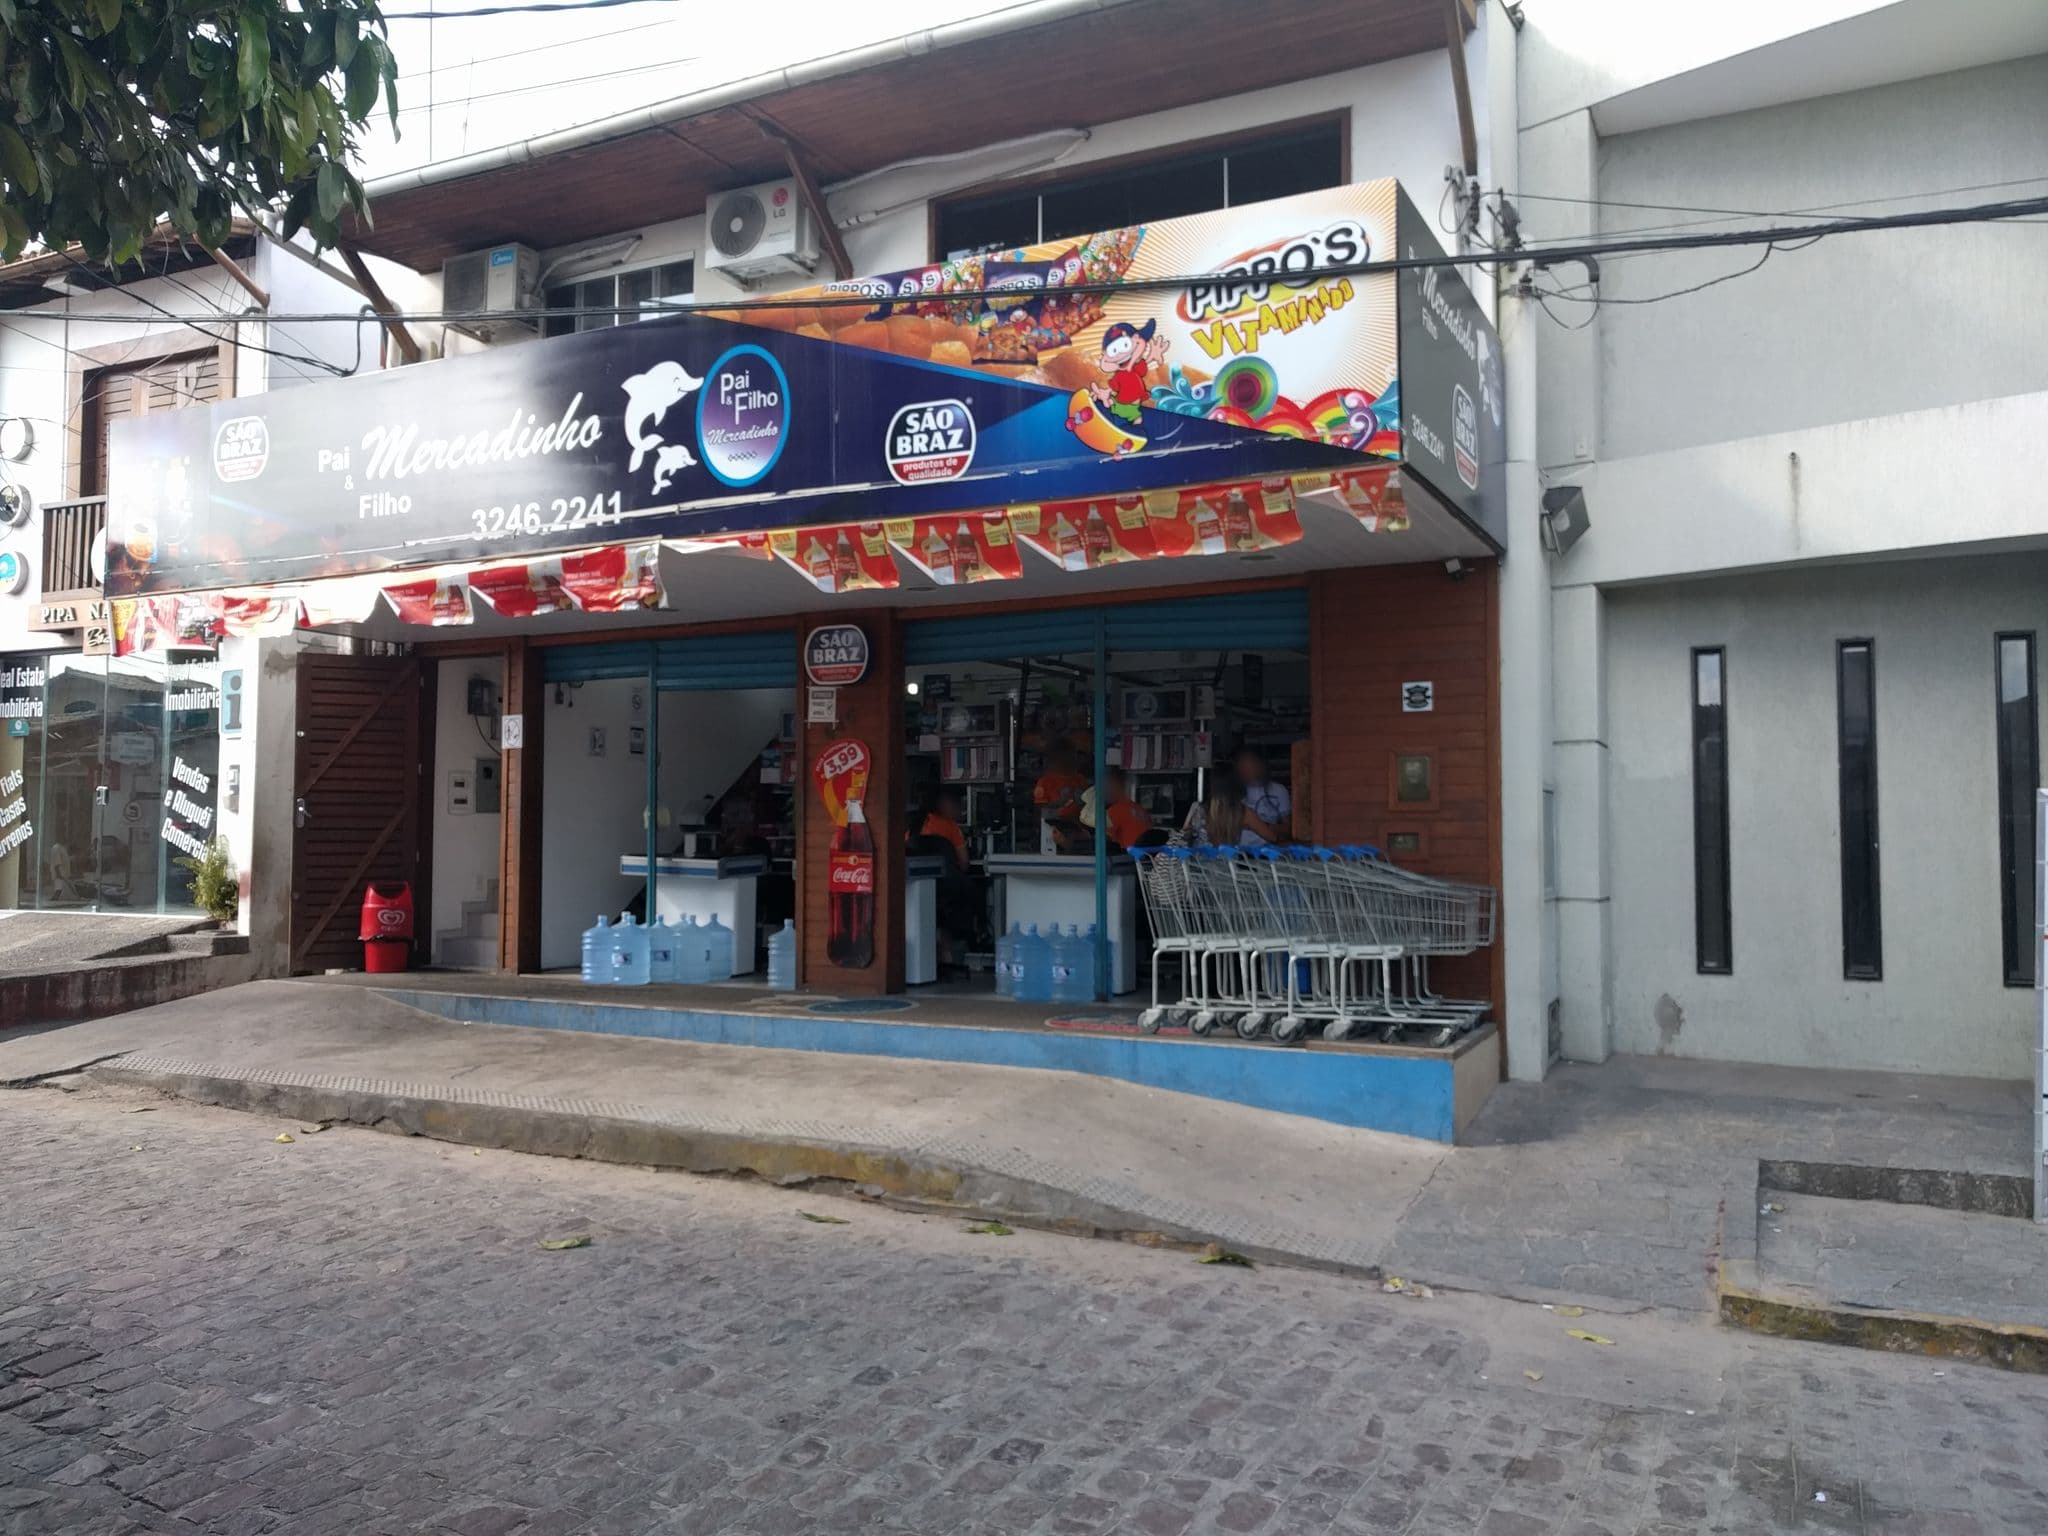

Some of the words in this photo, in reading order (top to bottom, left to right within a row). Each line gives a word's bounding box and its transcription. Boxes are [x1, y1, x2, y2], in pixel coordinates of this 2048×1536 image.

[1190, 277, 1354, 360] VITAMINADO
[720, 369, 750, 405] Pai
[726, 395, 733, 405] &
[735, 390, 779, 426] Filho
[905, 407, 954, 434] SÃO
[361, 391, 603, 480] Mercadinho
[708, 420, 779, 446] Mercadinho
[897, 428, 964, 456] BRAZ
[318, 446, 350, 473] Pai
[903, 460, 944, 473] produtos
[344, 474, 354, 490] &
[359, 491, 412, 519] Filho
[471, 490, 622, 542] 3246.2241
[40, 607, 76, 623] PIPA
[813, 646, 860, 664] BRAZ
[0, 667, 14, 688] eal
[16, 666, 45, 687] Estate
[0, 697, 43, 718] mobiliária
[165, 688, 220, 711] Imobiliária
[826, 746, 858, 773] 3,99
[172, 756, 210, 794] Vendas
[164, 789, 173, 806] e
